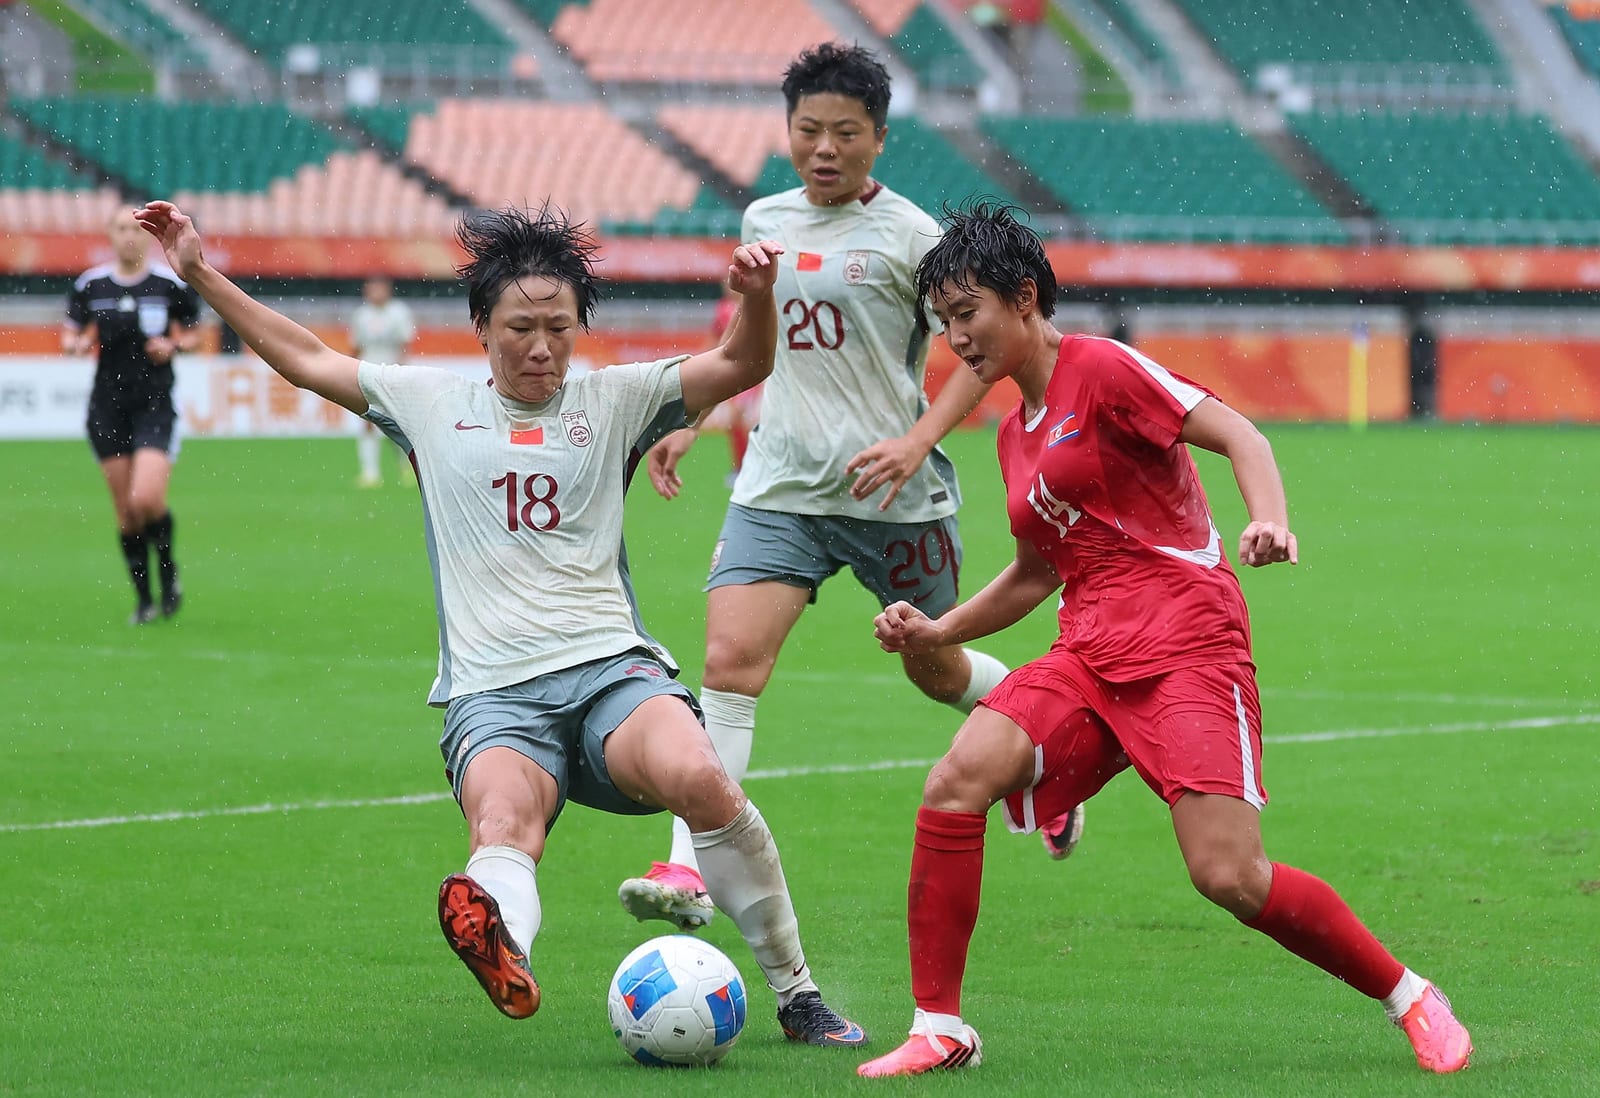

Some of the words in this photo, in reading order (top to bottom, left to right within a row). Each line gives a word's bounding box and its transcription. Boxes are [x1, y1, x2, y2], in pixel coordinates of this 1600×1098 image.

[783, 298, 845, 350] 20
[563, 412, 585, 423] CFA
[491, 471, 561, 532] 18
[1026, 471, 1082, 539] 14
[885, 527, 949, 590] 20
